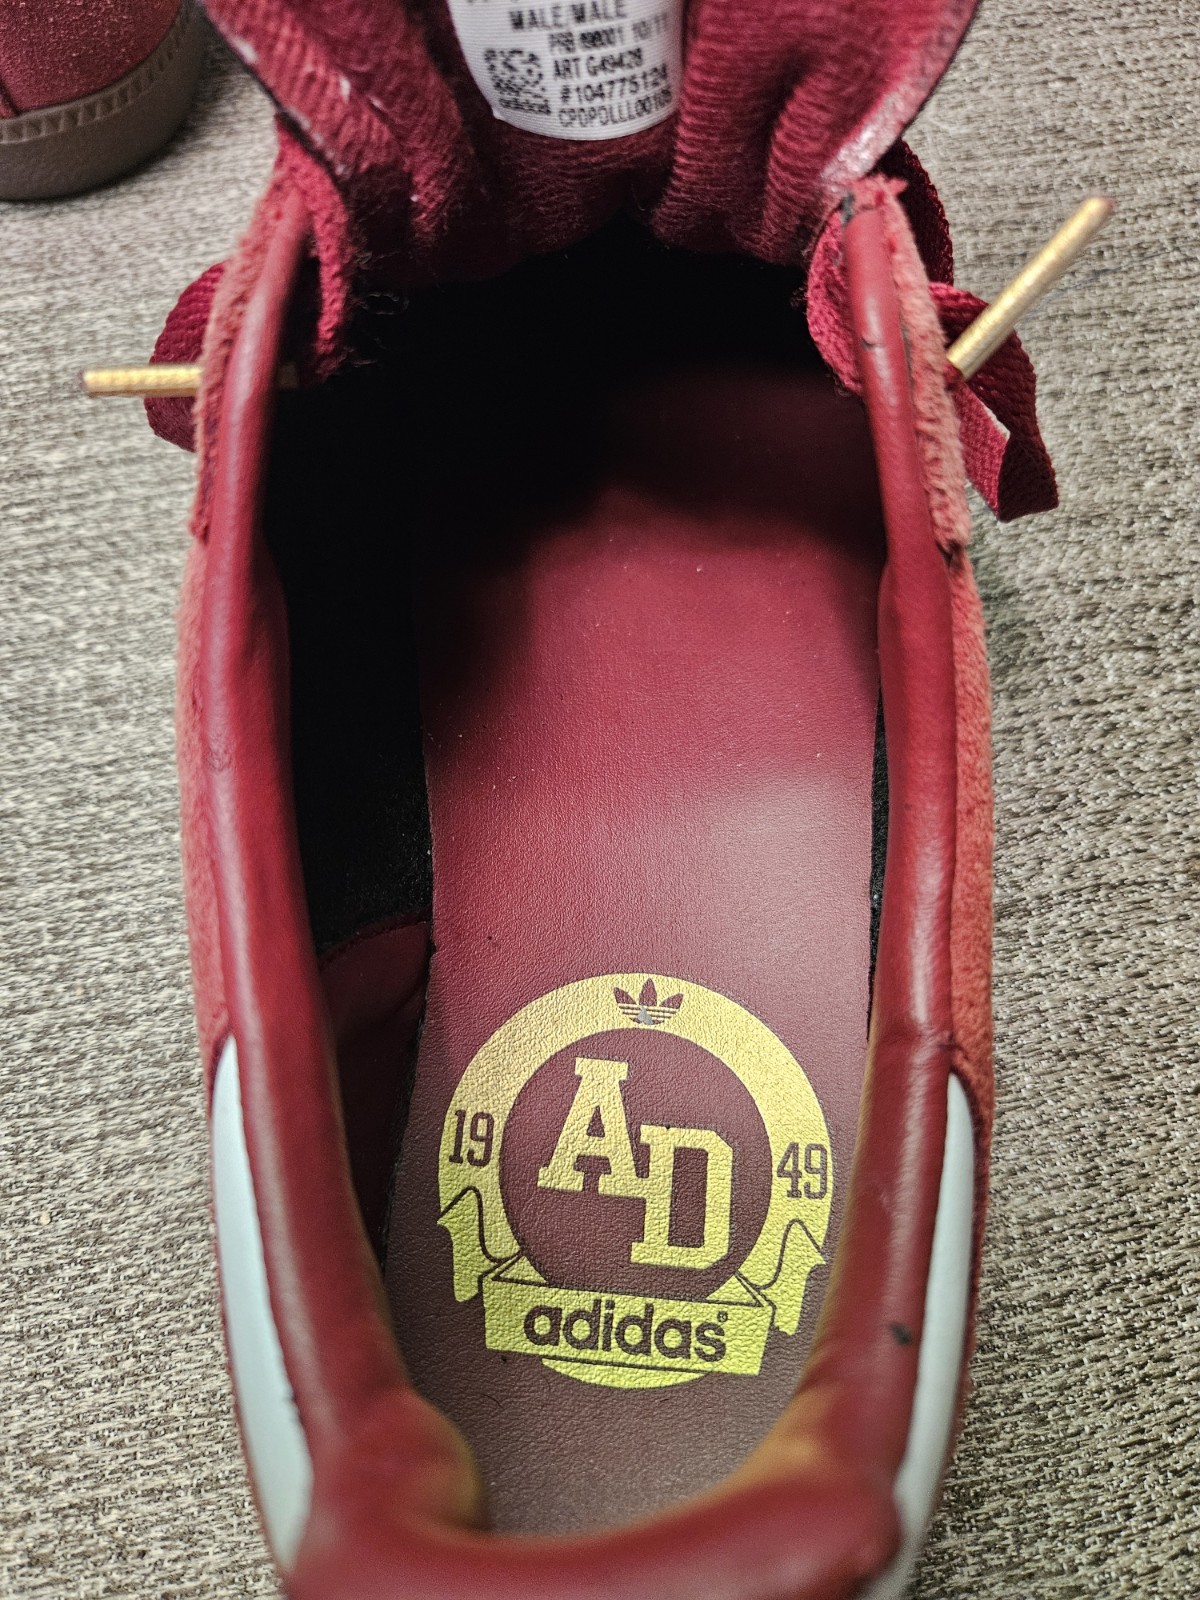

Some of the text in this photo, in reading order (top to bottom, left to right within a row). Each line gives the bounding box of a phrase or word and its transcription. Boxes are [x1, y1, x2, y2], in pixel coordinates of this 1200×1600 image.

[553, 58, 581, 80] ART
[448, 1109, 495, 1168] 19
[537, 1056, 734, 1270] AD
[776, 1142, 829, 1200] 49
